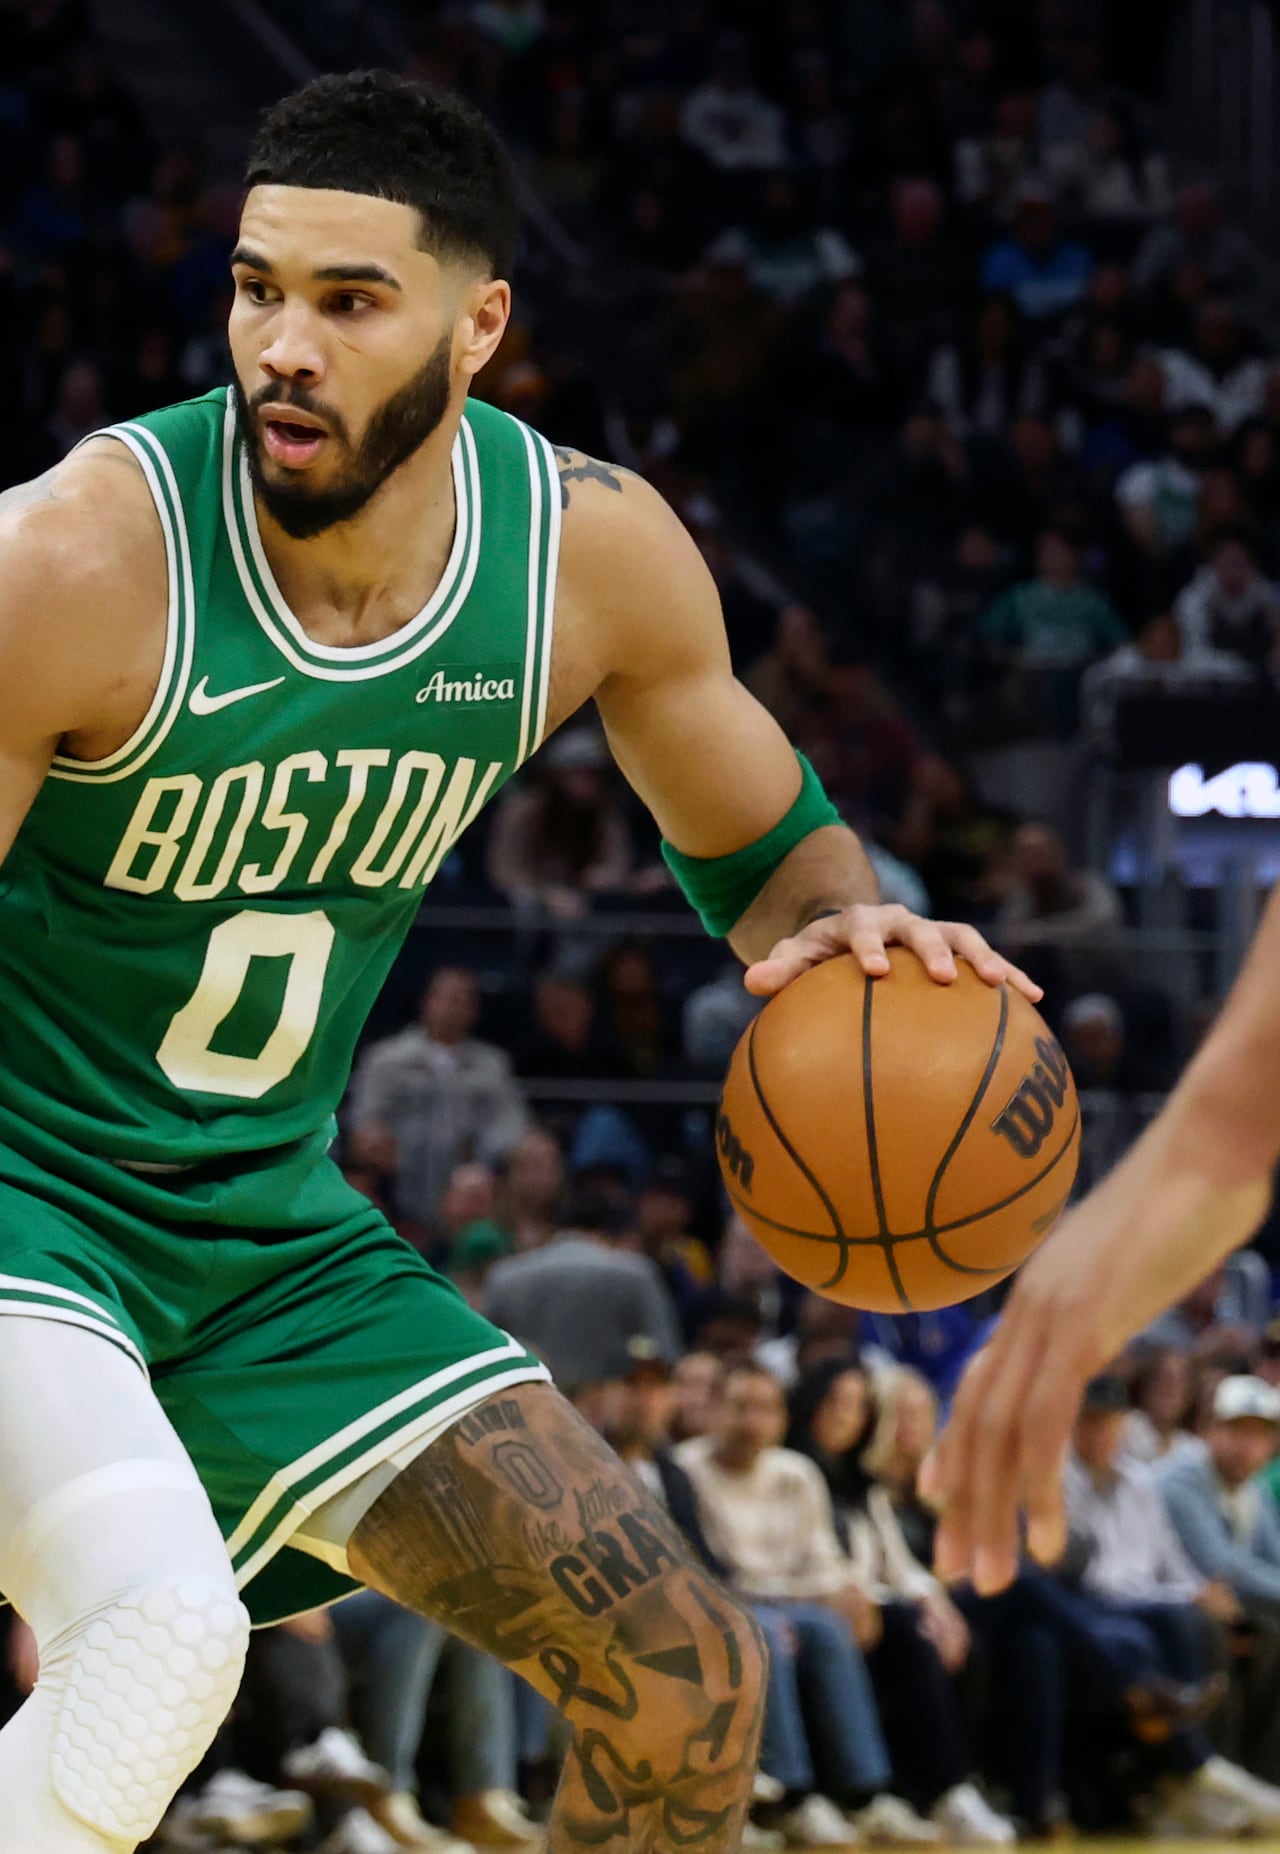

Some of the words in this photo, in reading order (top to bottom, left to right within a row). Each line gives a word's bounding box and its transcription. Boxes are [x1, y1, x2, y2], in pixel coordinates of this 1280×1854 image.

[416, 671, 515, 704] Amica
[103, 748, 503, 902] BOSTON
[155, 909, 336, 1099] 0
